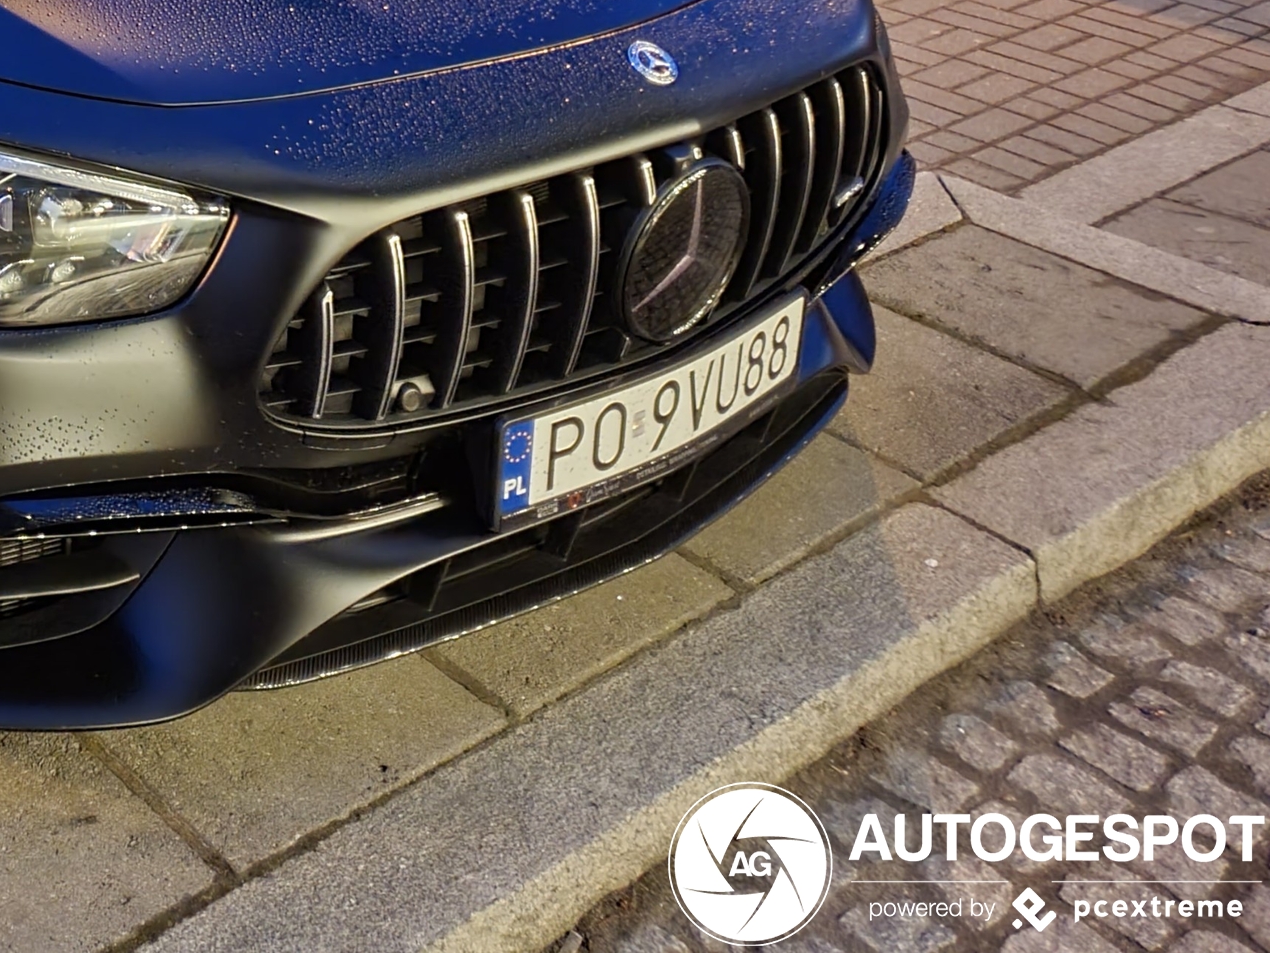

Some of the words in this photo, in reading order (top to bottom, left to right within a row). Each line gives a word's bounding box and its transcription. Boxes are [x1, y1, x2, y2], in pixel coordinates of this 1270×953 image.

[545, 401, 627, 491] PO
[651, 315, 790, 453] 9VU88
[503, 476, 527, 500] PL
